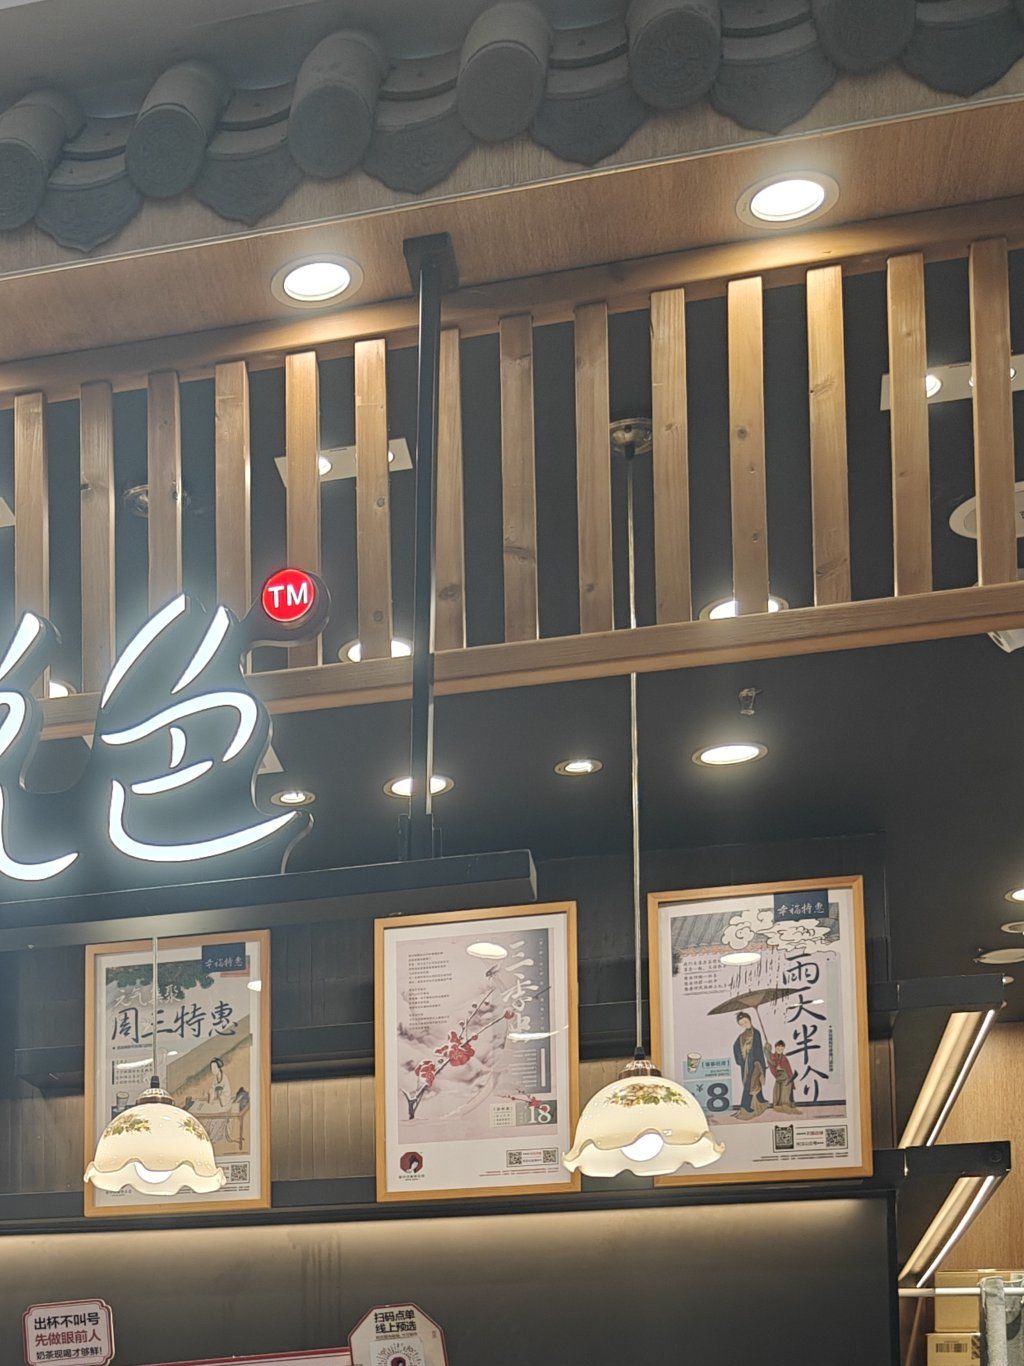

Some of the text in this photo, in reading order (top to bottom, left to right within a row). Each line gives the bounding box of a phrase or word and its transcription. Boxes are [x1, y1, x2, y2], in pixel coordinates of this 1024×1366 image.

[268, 584, 309, 611] TM
[776, 902, 825, 917] 幸福特惠
[111, 1001, 238, 1044] 周三特惠
[783, 949, 829, 1103] 雨天半价
[34, 1312, 100, 1330] 出杯不叫号
[36, 1329, 101, 1347] 先做眼前人
